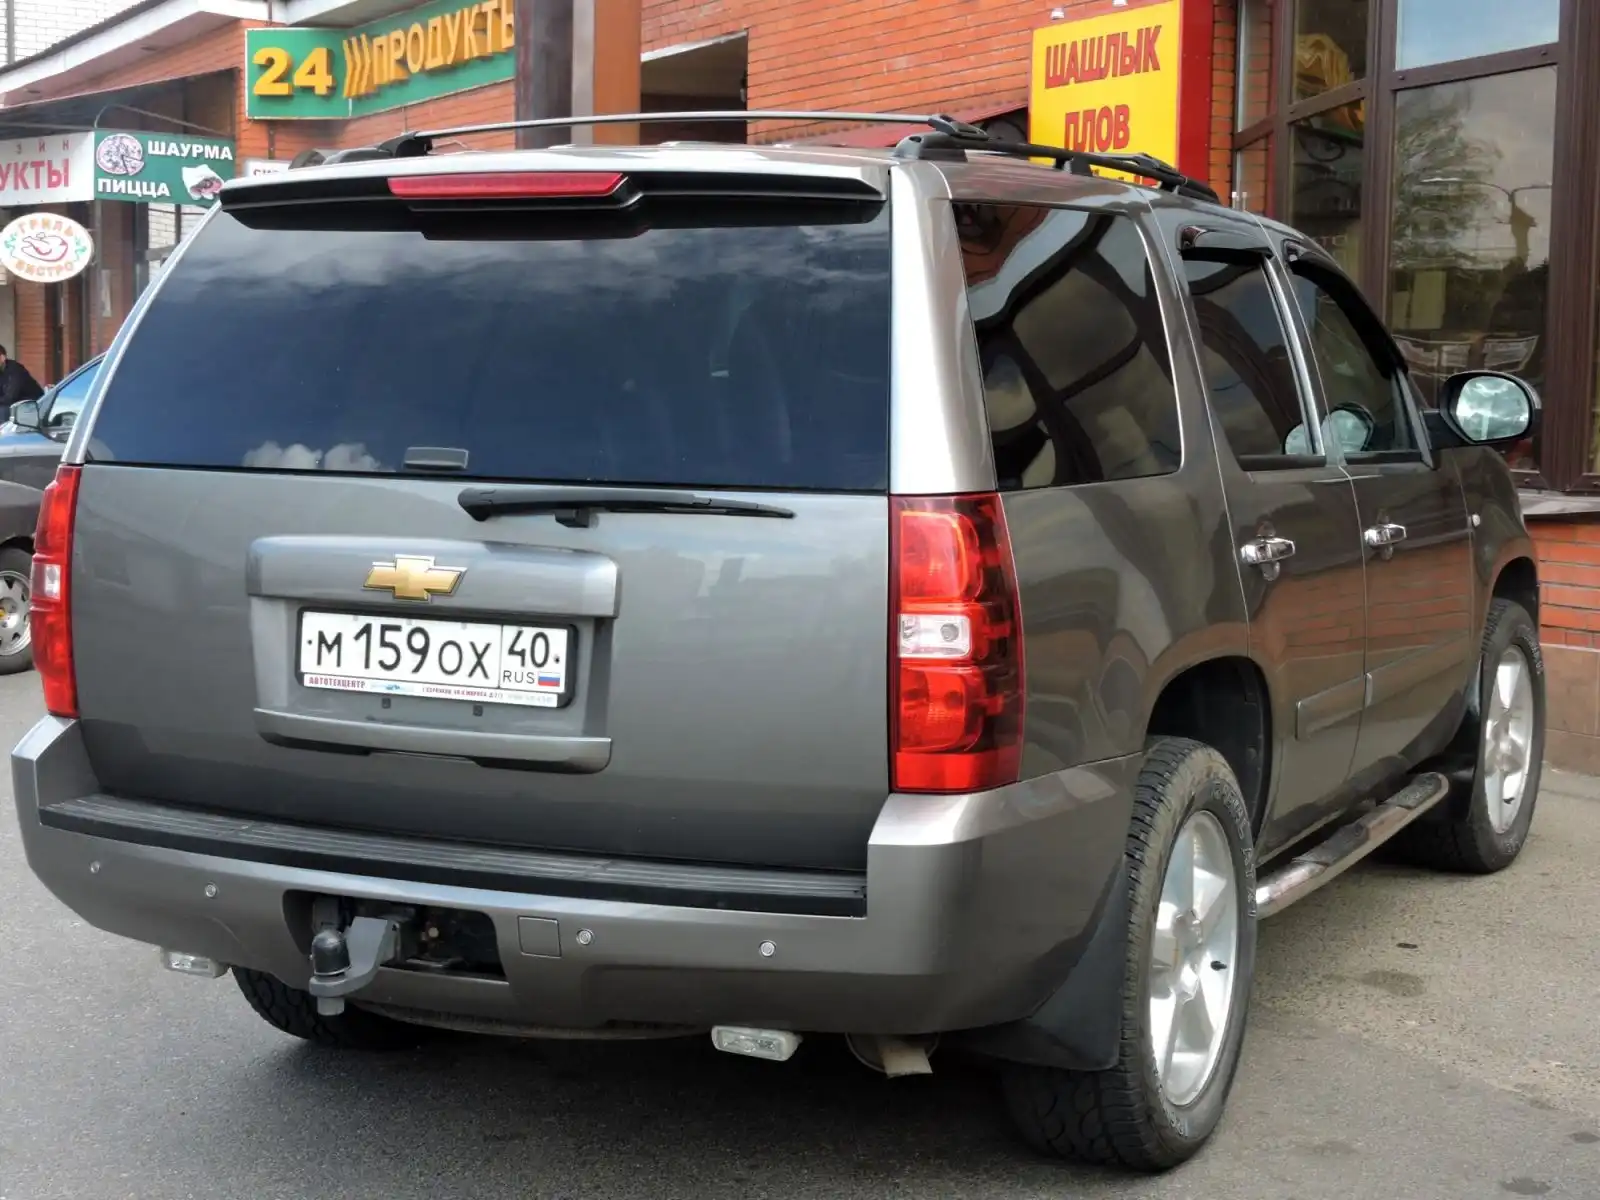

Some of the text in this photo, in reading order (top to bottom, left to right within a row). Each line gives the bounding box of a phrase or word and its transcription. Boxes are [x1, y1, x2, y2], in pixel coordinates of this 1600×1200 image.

[253, 47, 333, 96] 24
[1044, 25, 1162, 89] ШАШЛЫК
[1064, 104, 1130, 153] ПЛОВ
[147, 140, 233, 161] ШАУРМА
[97, 178, 170, 198] ПИЦЦА
[507, 630, 550, 668] 40
[308, 676, 366, 689] АВТОТЕХЦЕНТР
[503, 669, 535, 685] RUS
